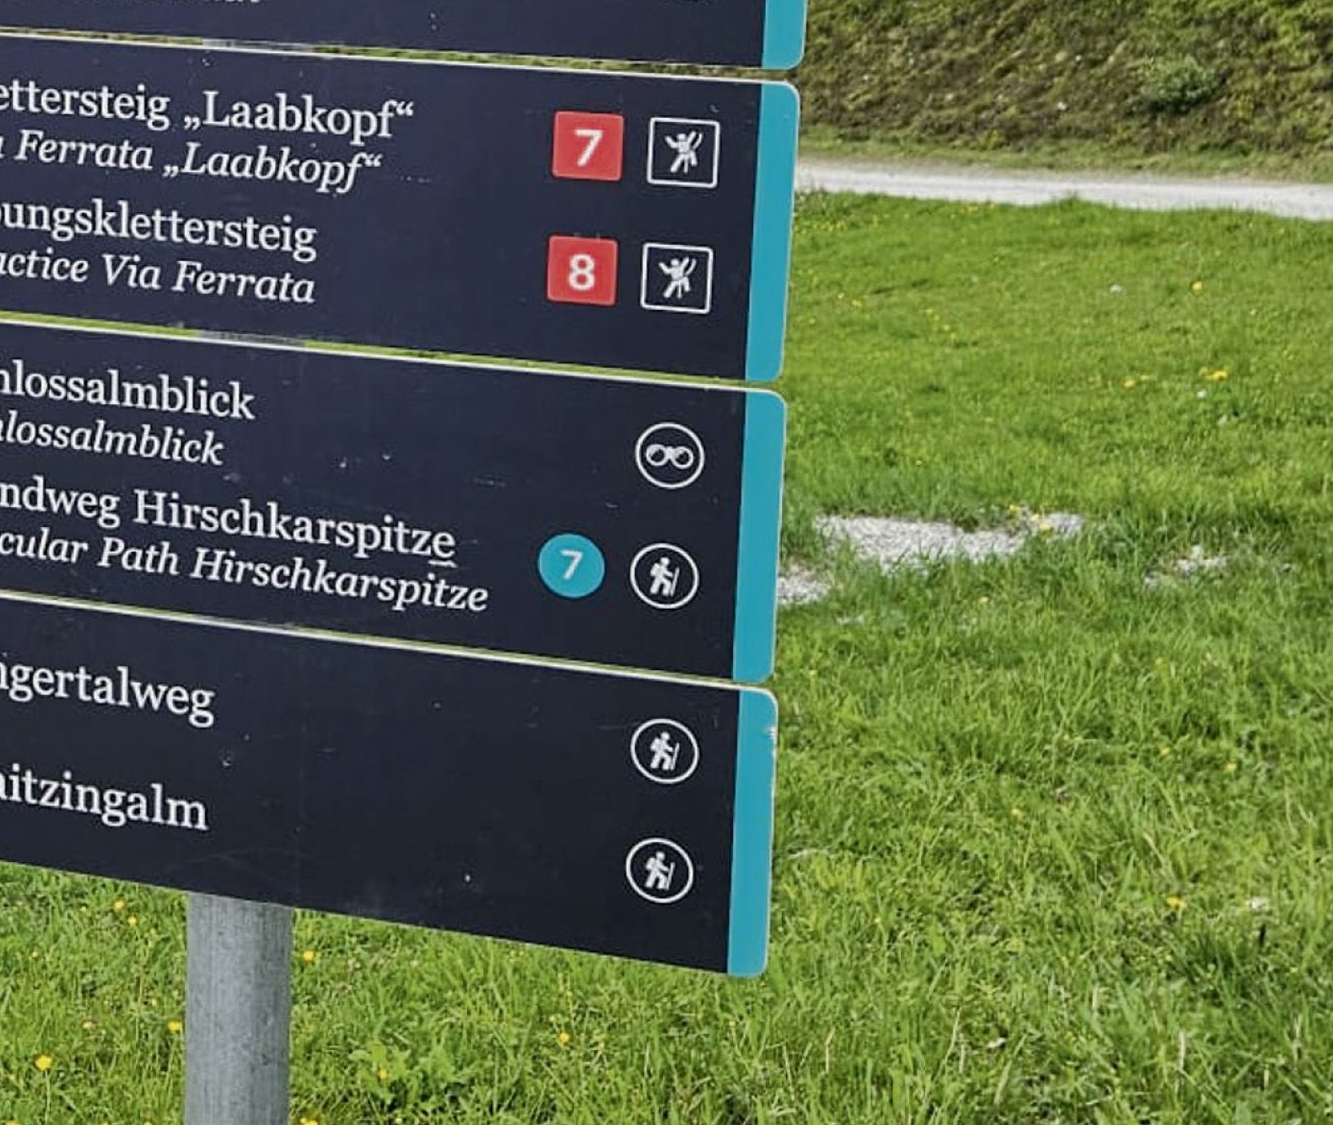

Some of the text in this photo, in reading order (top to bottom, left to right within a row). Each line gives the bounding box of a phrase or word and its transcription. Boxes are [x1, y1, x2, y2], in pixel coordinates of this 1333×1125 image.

[183, 90, 414, 147] „Laabkopf“
[13, 128, 153, 171] Ferrata
[162, 140, 383, 194] „Laabkopf“
[574, 129, 604, 167] 7
[102, 253, 161, 290] Via
[170, 260, 315, 304] Ferrata
[568, 253, 596, 292] 8
[133, 488, 457, 559] Hirschkarspitze
[96, 536, 180, 576] Path
[189, 546, 489, 612] Hirschkarspitze
[559, 547, 584, 581] 7
